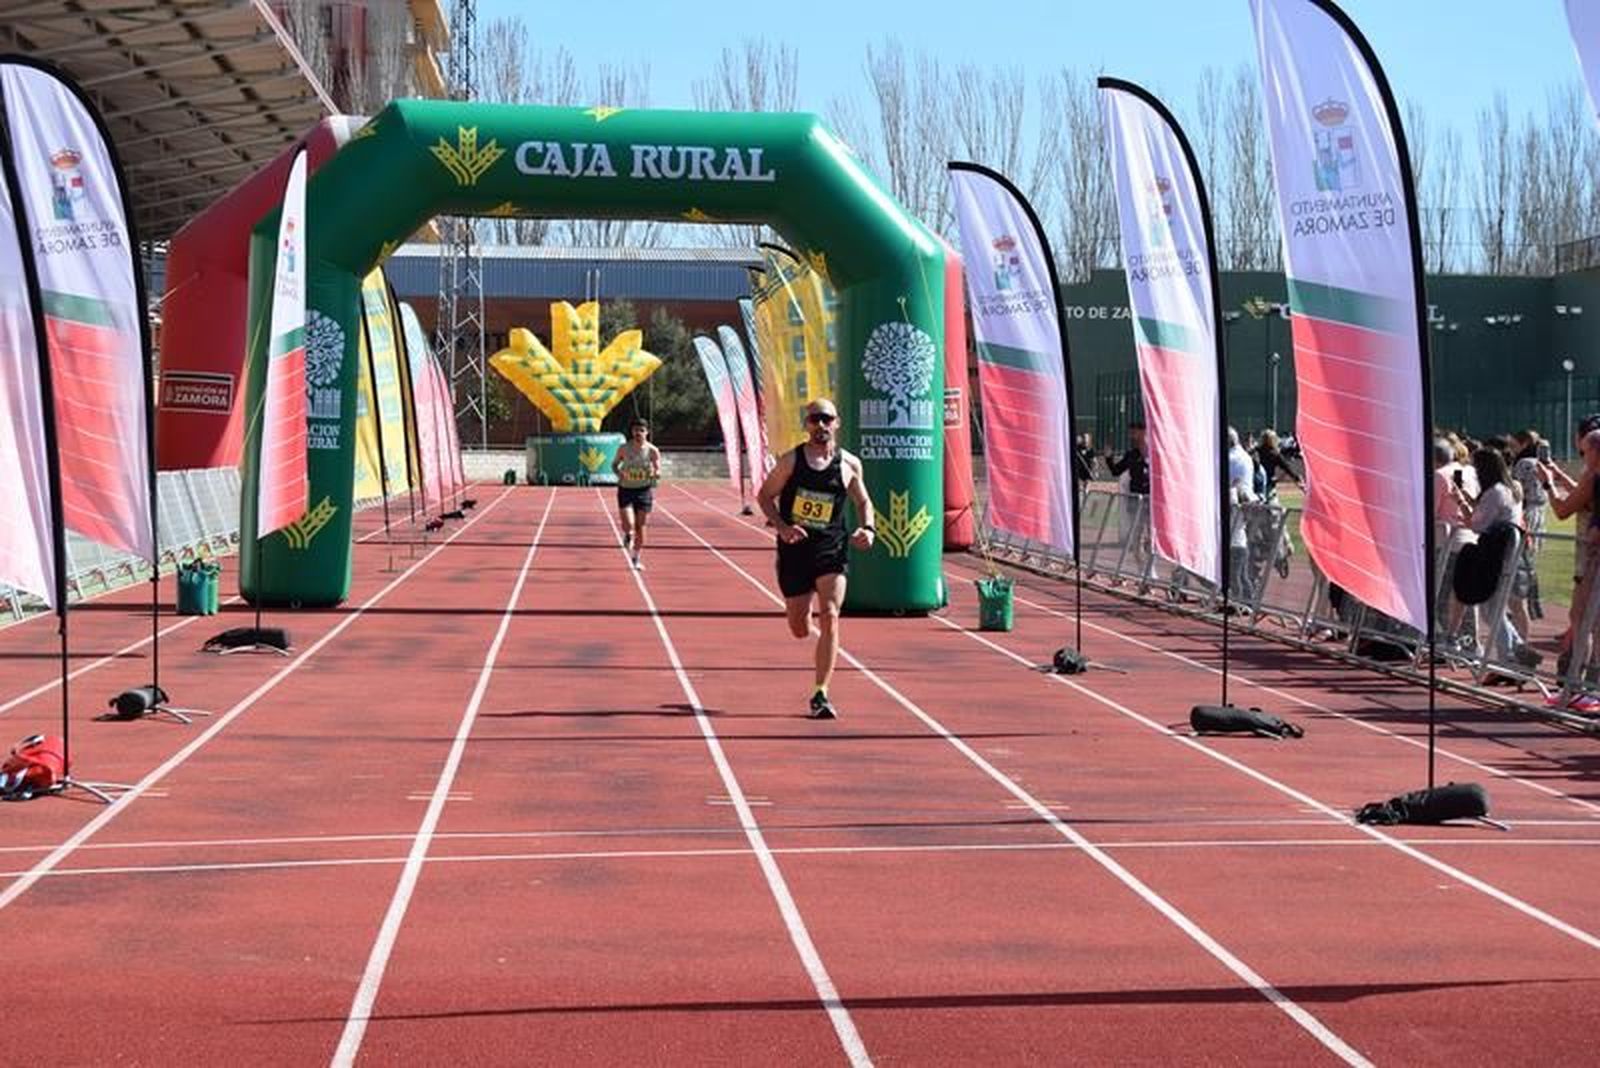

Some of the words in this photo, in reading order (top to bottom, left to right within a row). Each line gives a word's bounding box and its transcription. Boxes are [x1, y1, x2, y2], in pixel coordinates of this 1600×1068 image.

[514, 140, 617, 178] CAJA
[629, 143, 776, 182] RURAL
[1065, 305, 1085, 319] TO
[1088, 306, 1108, 319] DE
[1112, 306, 1132, 319] ZA
[174, 393, 229, 407] ZAMORA
[307, 437, 341, 449] URAL
[860, 434, 934, 447] FUNDACION
[860, 447, 893, 460] CAJA
[895, 447, 936, 460] RURAL
[801, 501, 823, 518] 93
